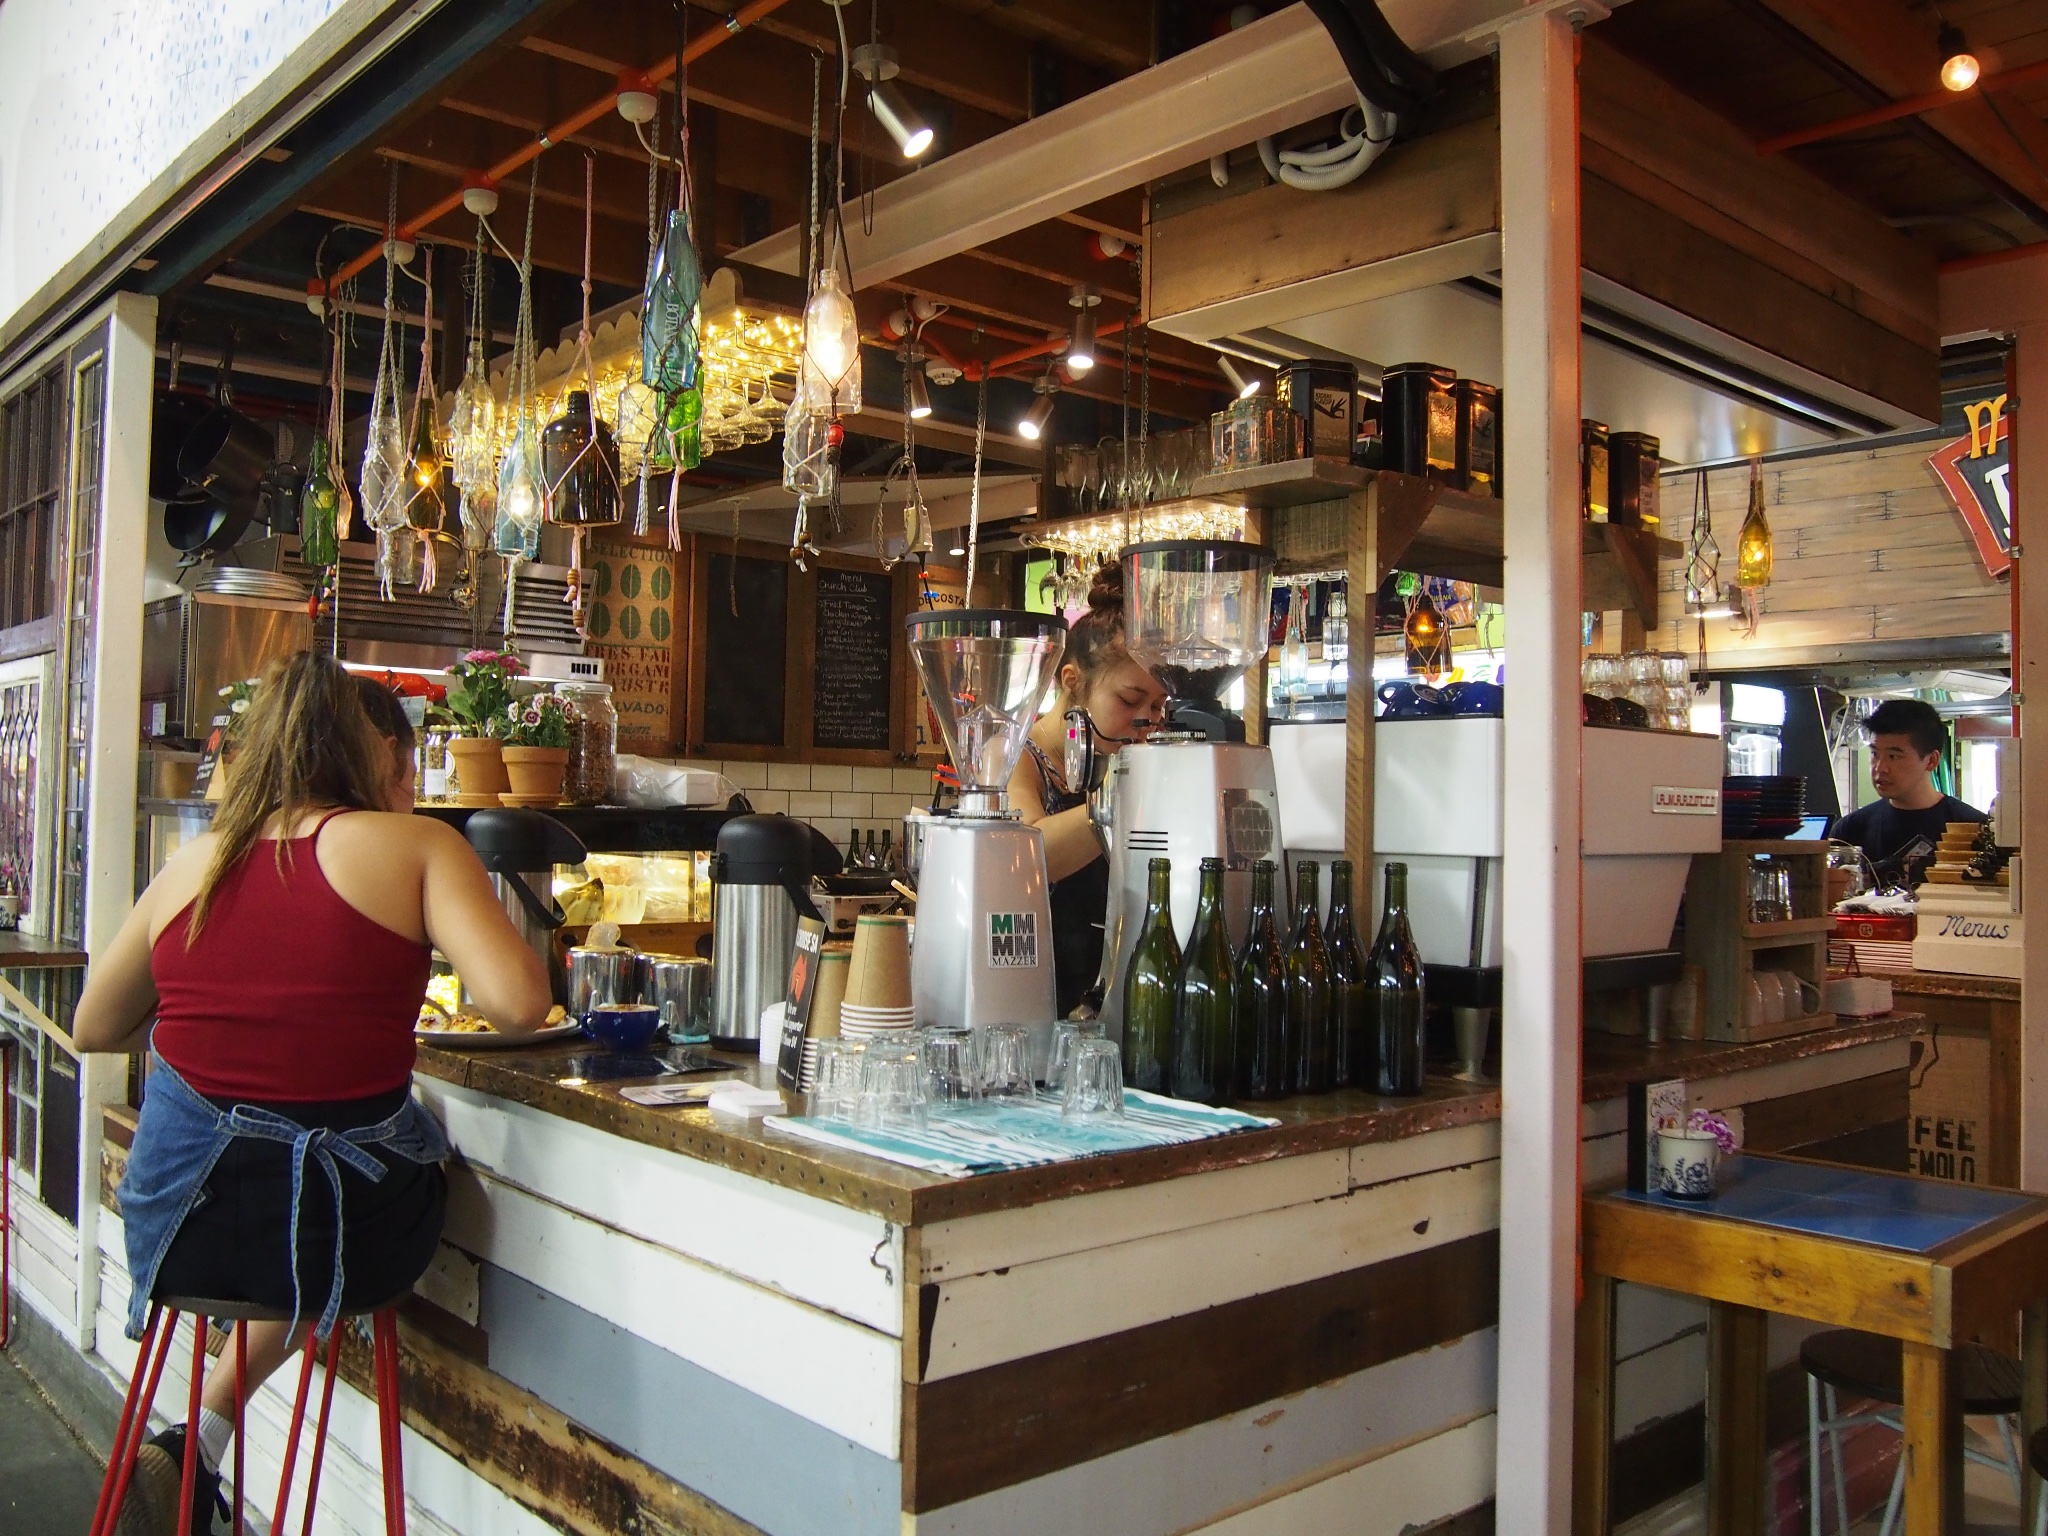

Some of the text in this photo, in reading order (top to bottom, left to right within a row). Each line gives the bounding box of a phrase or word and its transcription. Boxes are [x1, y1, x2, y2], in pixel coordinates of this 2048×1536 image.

[591, 542, 674, 566] SELECTION
[934, 592, 966, 608] COSTA
[1938, 914, 2010, 940] Menus
[991, 956, 1036, 967] MAZZER
